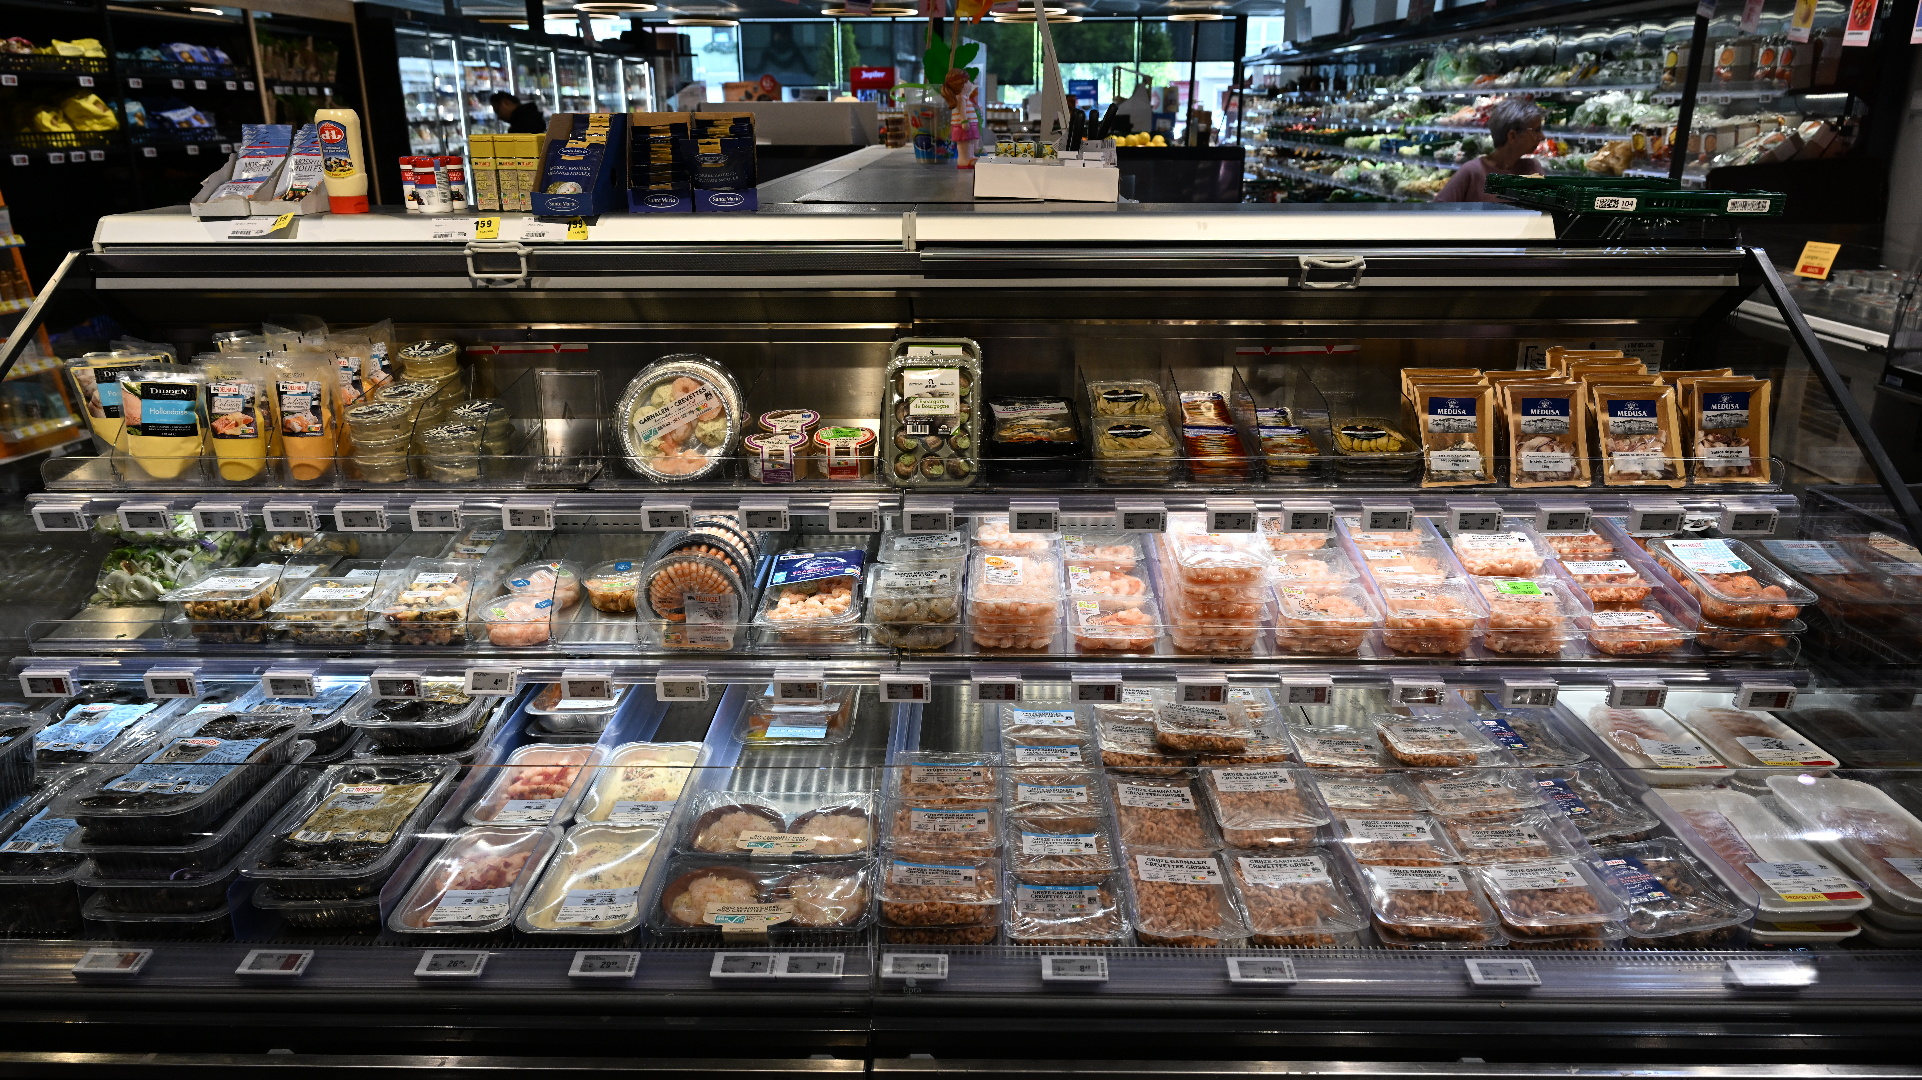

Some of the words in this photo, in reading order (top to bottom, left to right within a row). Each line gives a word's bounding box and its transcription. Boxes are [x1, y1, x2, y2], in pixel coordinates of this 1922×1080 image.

[861, 70, 885, 79] Jupiler
[473, 219, 492, 231] 159
[566, 219, 583, 232] 199
[149, 387, 188, 395] DIDDEN
[638, 407, 670, 425] GARNALEN
[674, 387, 707, 407] CREVETTES
[149, 407, 188, 416] Hollandaise
[902, 985, 922, 995] Epta
